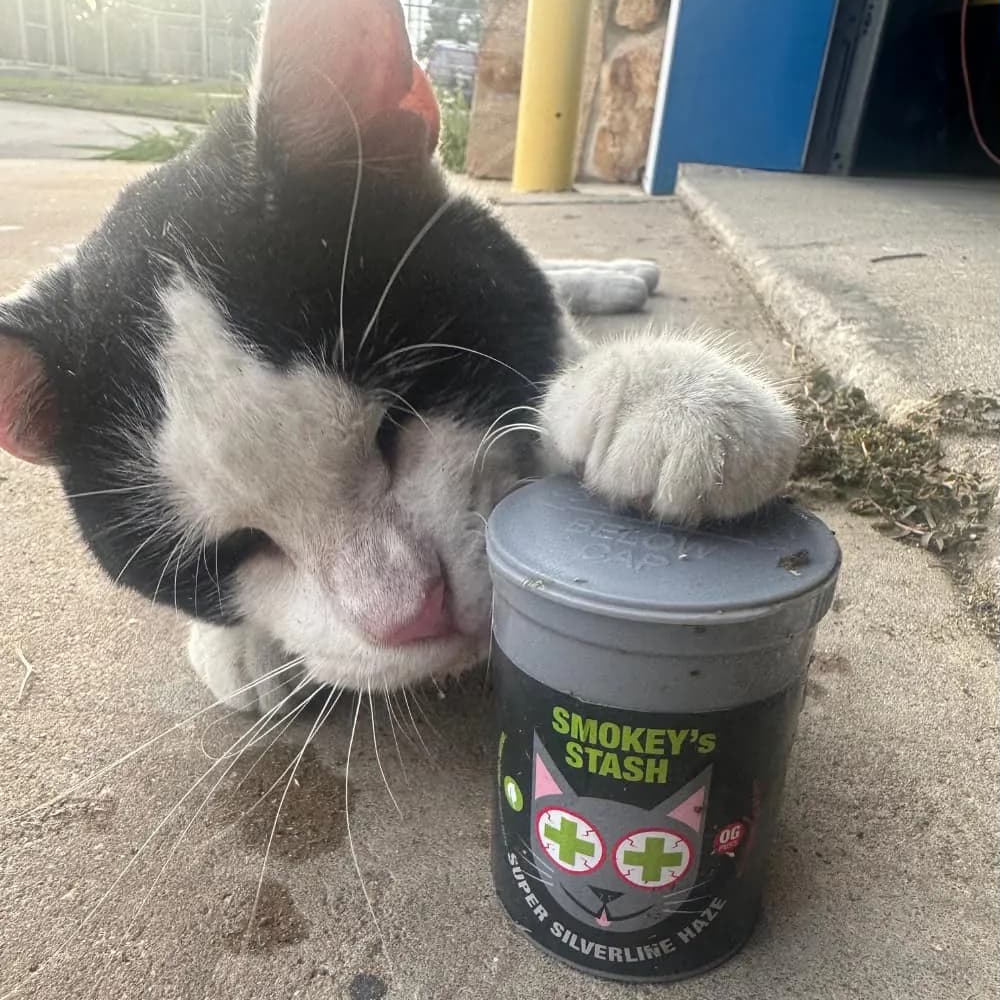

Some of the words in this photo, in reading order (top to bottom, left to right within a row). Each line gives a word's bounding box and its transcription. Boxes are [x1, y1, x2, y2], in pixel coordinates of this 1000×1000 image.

[551, 706, 718, 756] SMOKEY's
[565, 741, 669, 784] STASH
[719, 825, 740, 845] OG
[507, 852, 549, 923] SUPER
[549, 920, 677, 964] SILVERLINE
[676, 897, 728, 945] HAZE
